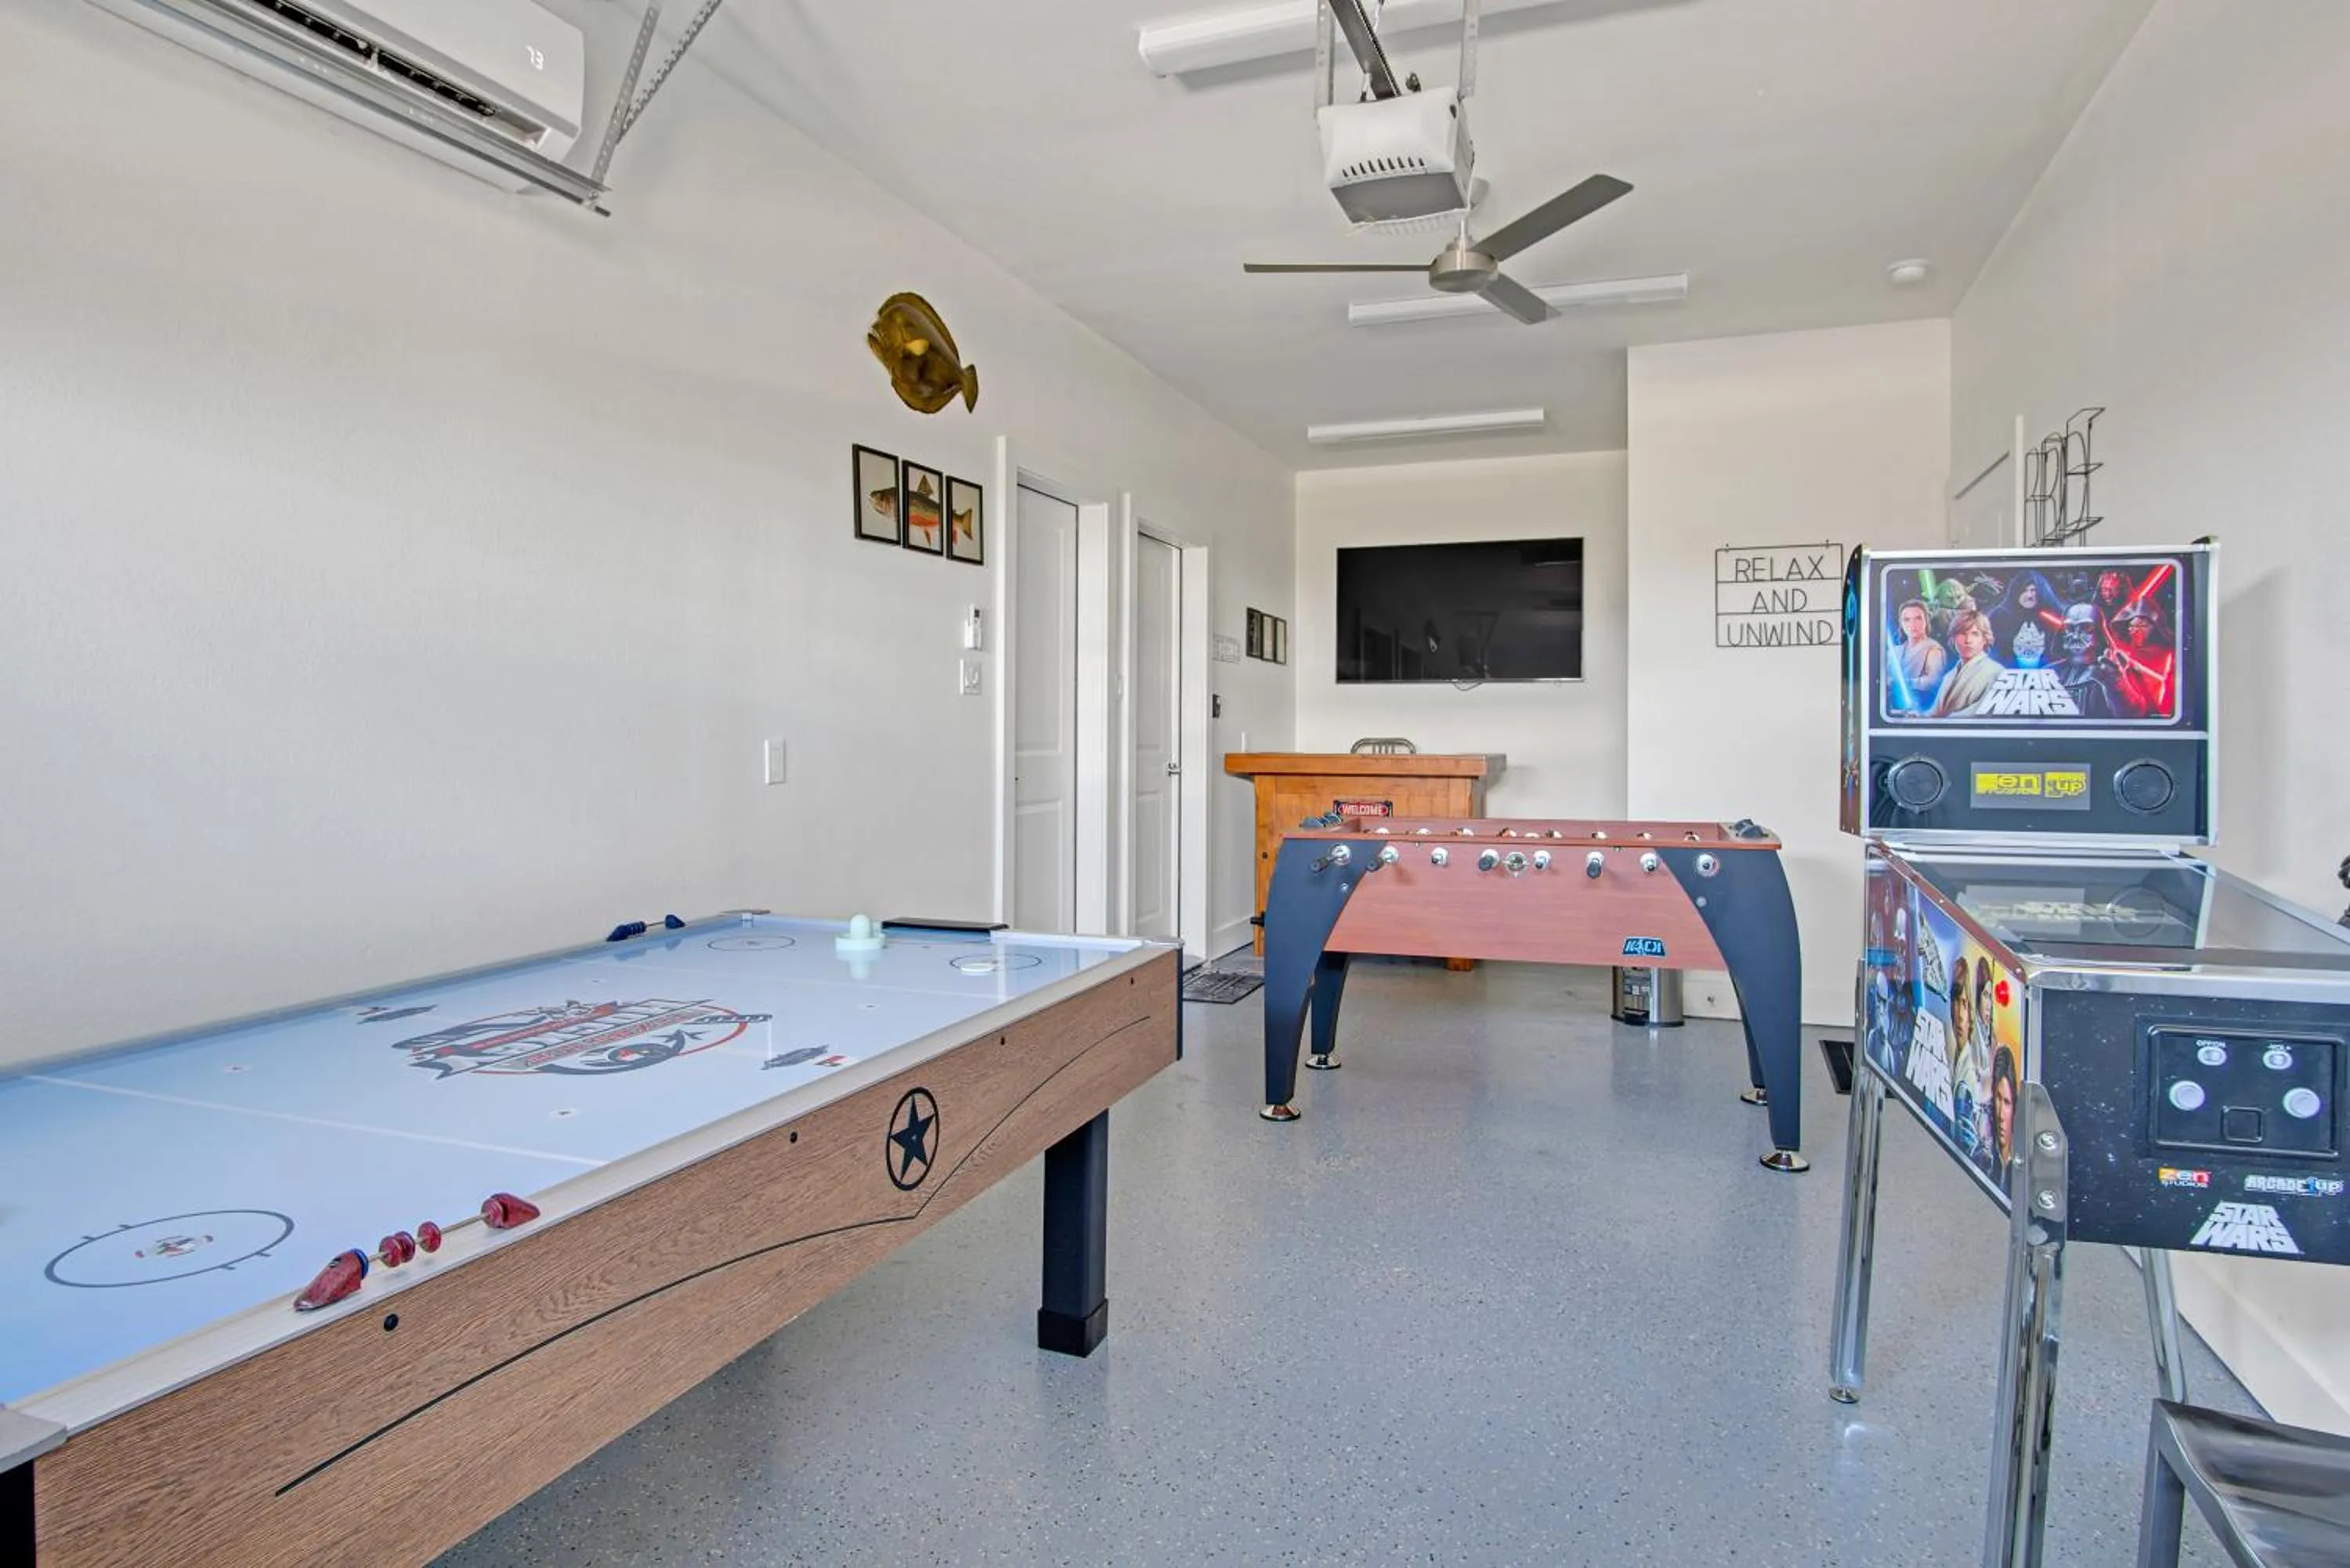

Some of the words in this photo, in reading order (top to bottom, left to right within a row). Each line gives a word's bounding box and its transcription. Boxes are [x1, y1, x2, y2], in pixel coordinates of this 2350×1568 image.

[1735, 553, 1825, 582] RELAX
[1752, 589, 1808, 613] AND
[1727, 620, 1834, 646] UNWIND
[1993, 669, 2066, 690] STAR
[1976, 689, 2081, 715] WARS
[1342, 804, 1382, 815] WELCOME
[1914, 1007, 1948, 1066] STAR
[1905, 1038, 1955, 1122] WARS
[2207, 1201, 2283, 1227] STAR
[2190, 1220, 2301, 1254] WARS
